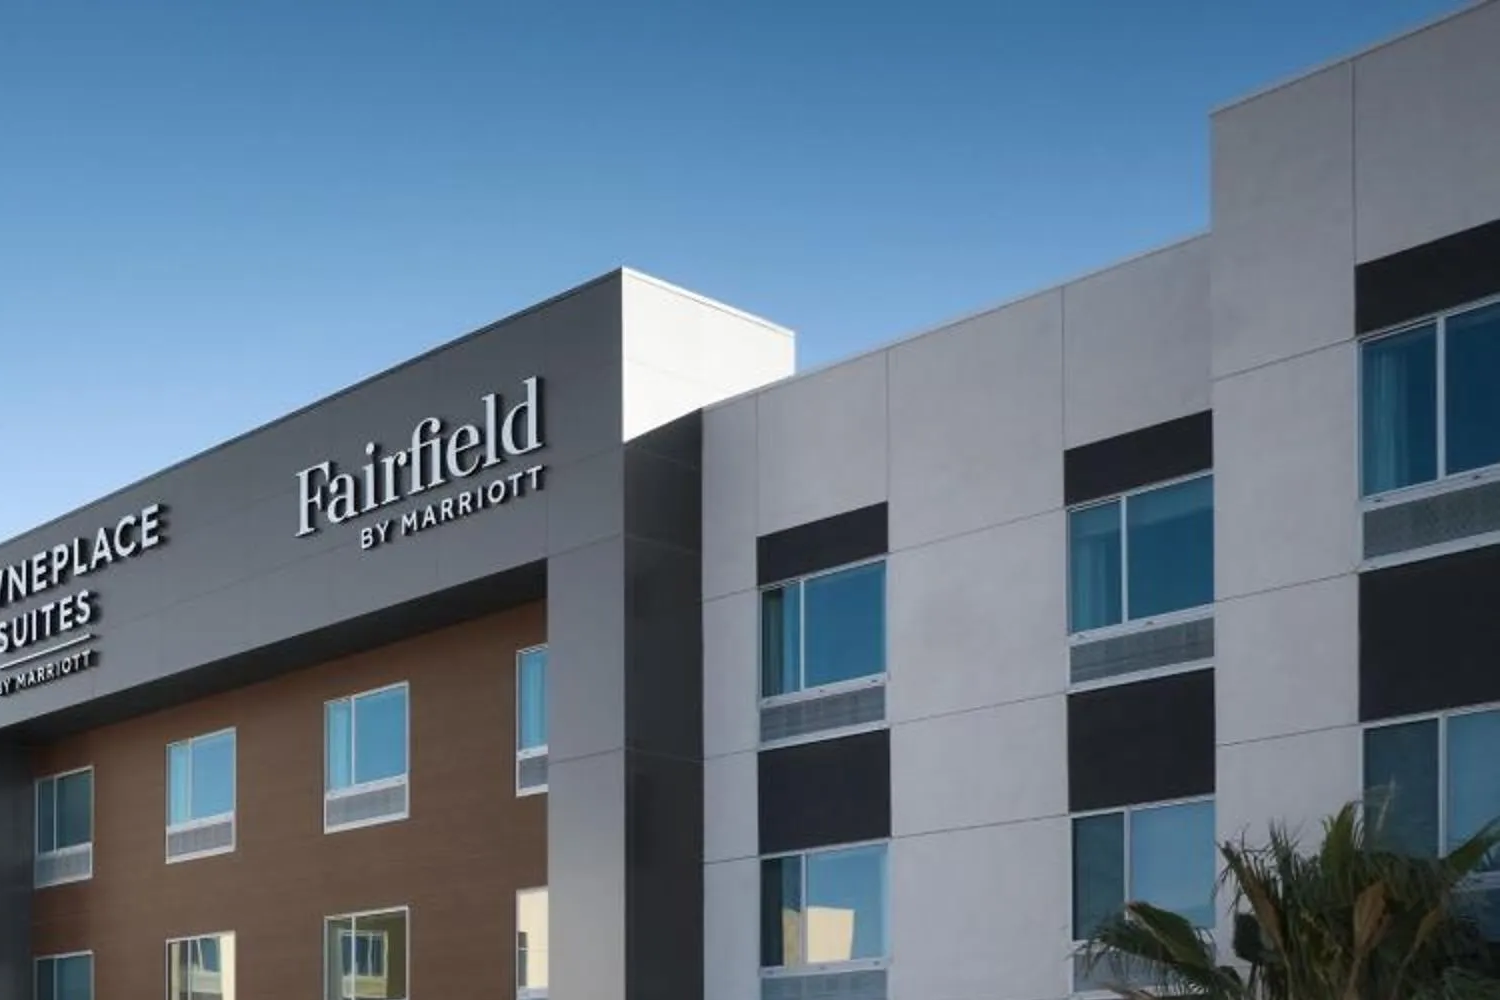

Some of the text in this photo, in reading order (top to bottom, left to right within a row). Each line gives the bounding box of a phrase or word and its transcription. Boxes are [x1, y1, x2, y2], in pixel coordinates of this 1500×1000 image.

[295, 375, 544, 537] Fairfield
[361, 464, 544, 549] BY MARRIOTT
[16, 650, 92, 690] MARRIOTT
